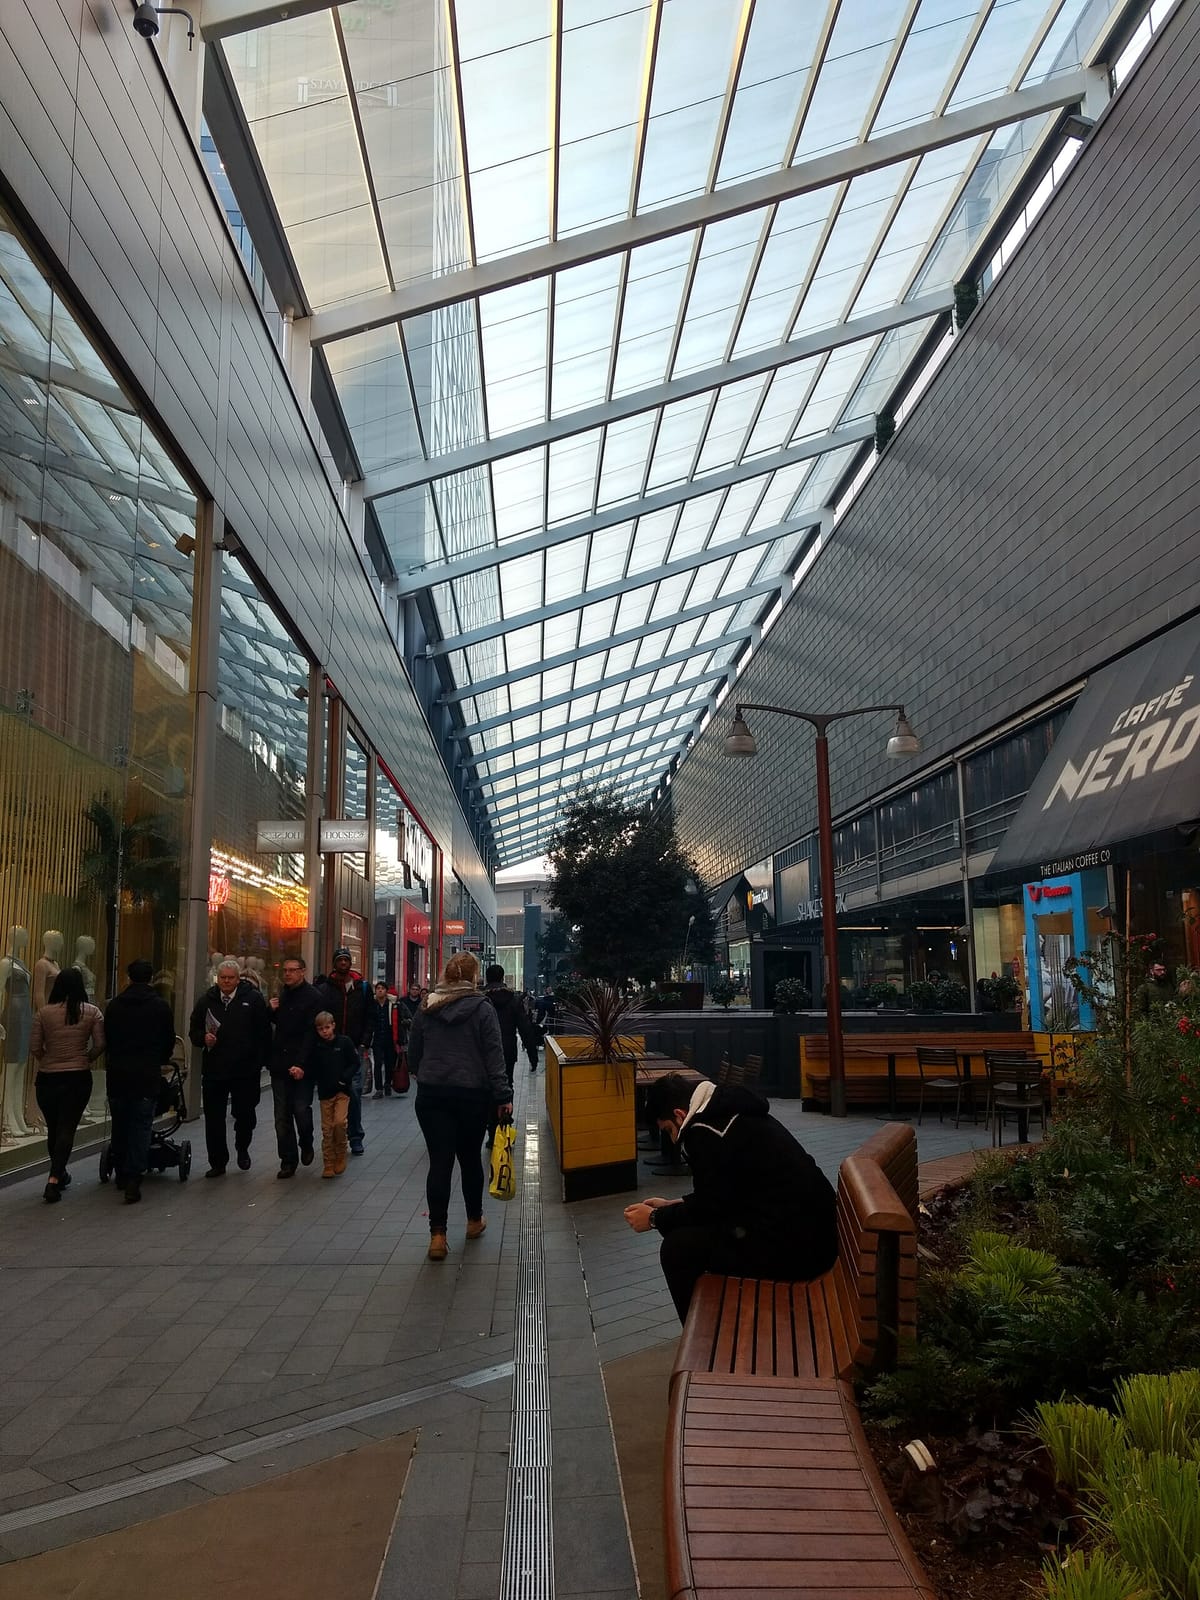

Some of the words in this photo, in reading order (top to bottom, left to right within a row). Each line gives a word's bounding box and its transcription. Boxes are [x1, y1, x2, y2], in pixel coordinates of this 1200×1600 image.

[1041, 703, 1200, 812] NERO
[1040, 865, 1052, 876] THE
[1052, 858, 1074, 874] ITALIAN
[1075, 852, 1099, 869] COFFEE
